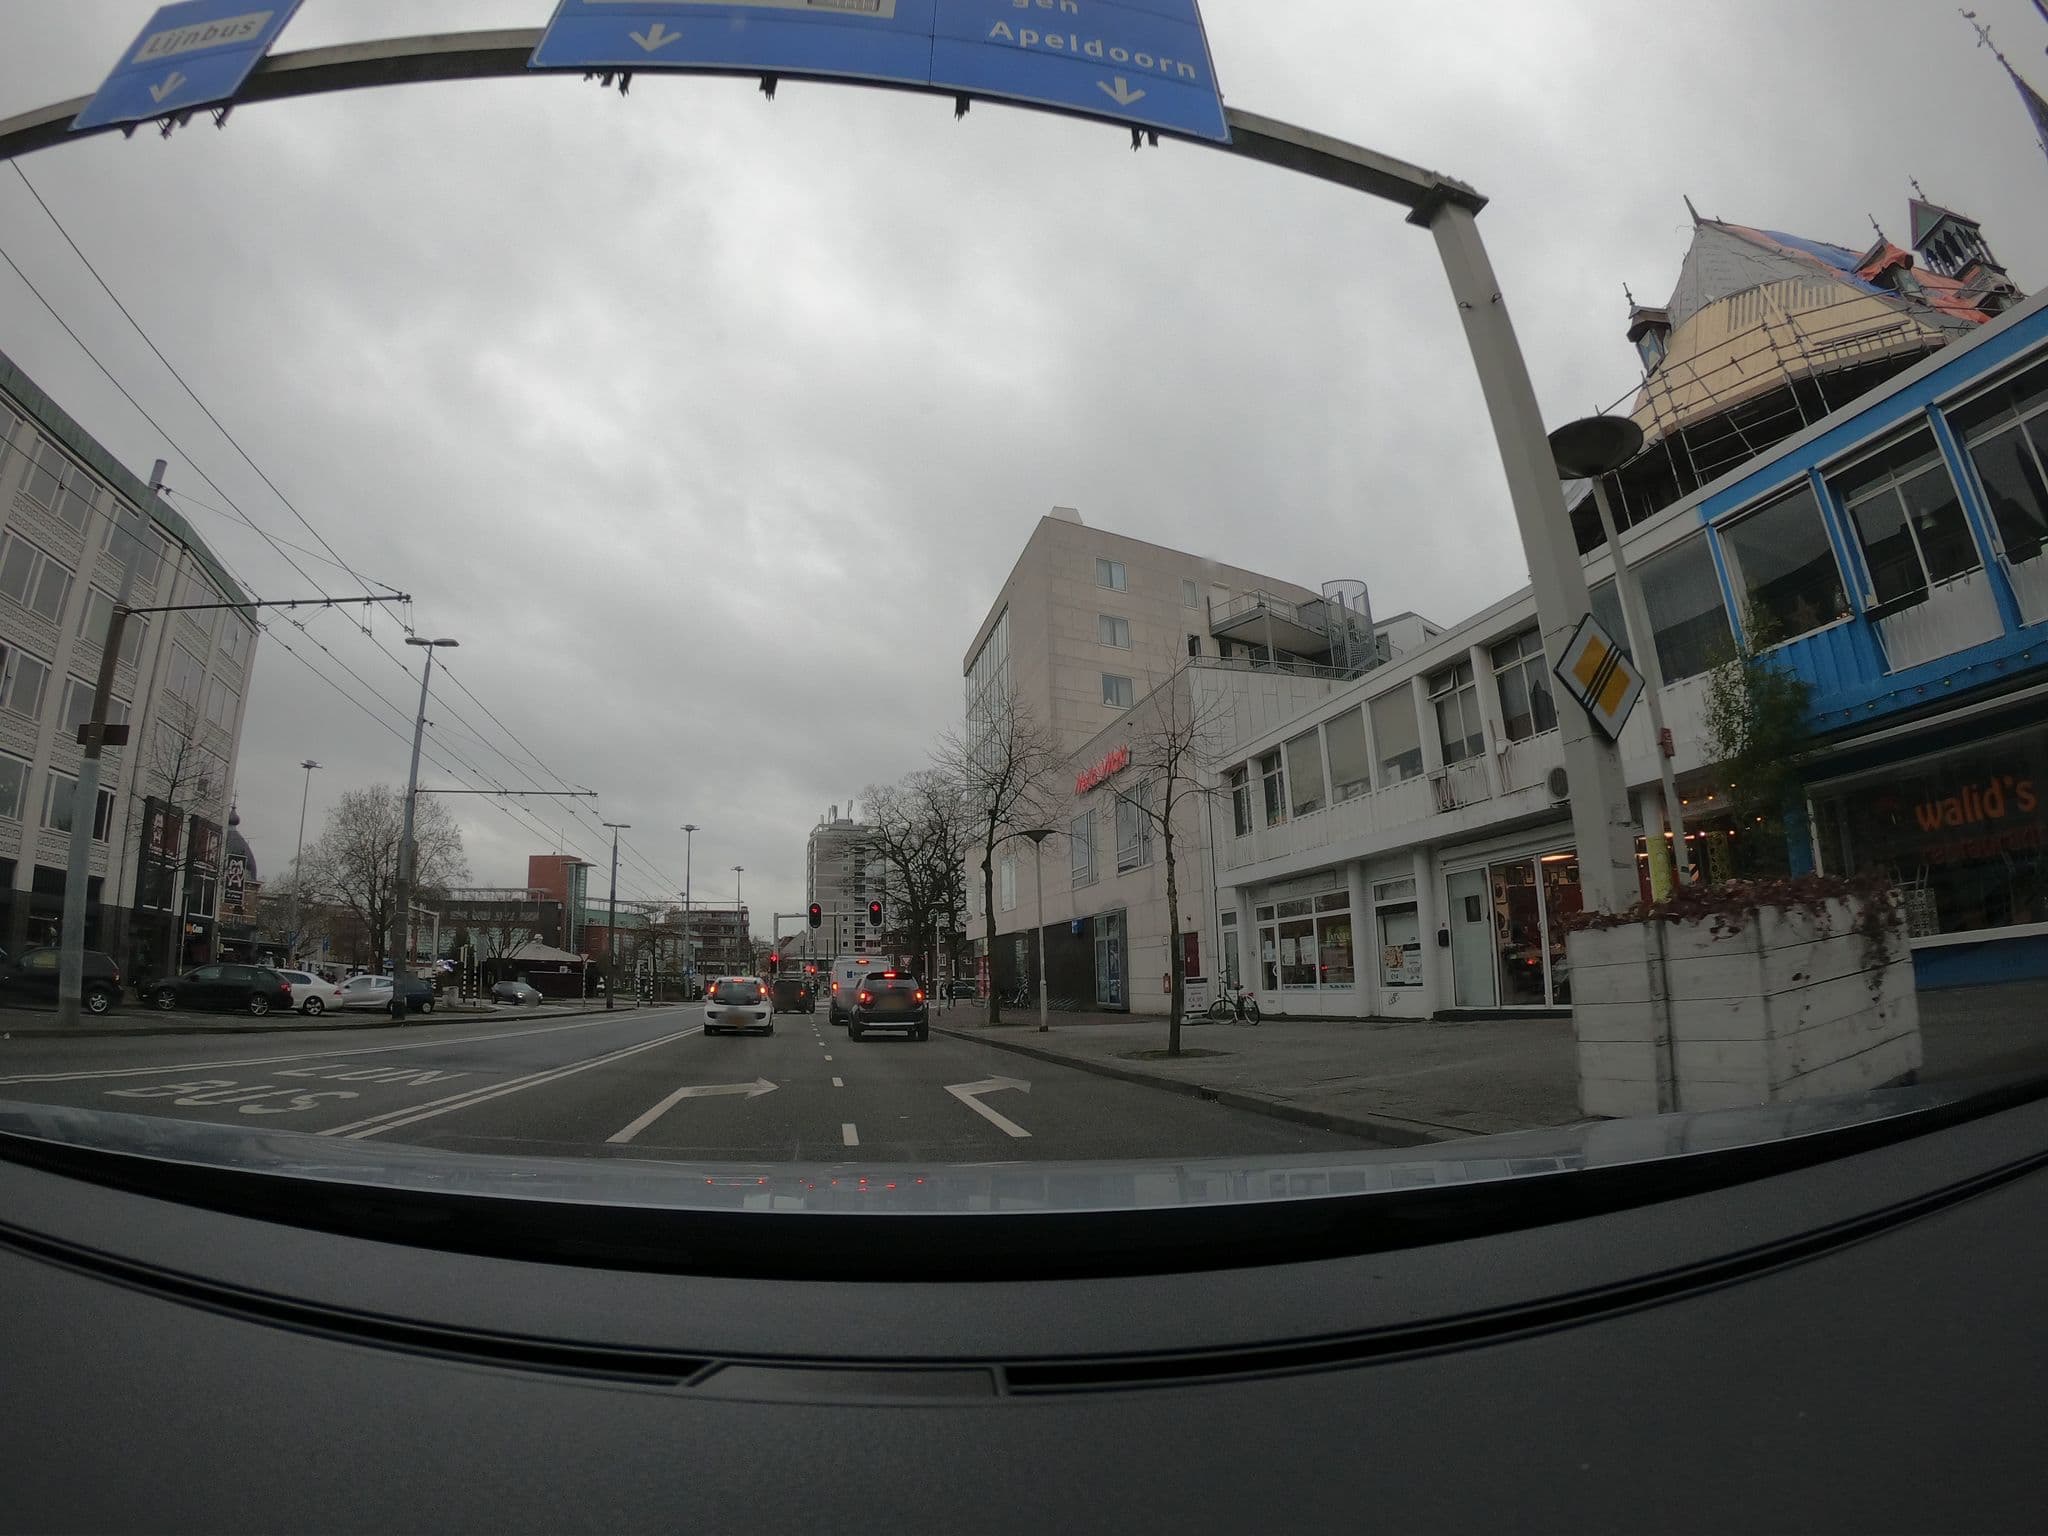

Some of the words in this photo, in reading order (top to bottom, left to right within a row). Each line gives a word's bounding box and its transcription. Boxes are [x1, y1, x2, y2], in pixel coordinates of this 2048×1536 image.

[148, 20, 257, 53] Lijnbus
[988, 20, 1196, 79] Apeldoorn
[1914, 774, 2039, 833] walid's
[103, 1080, 360, 1114] BUS
